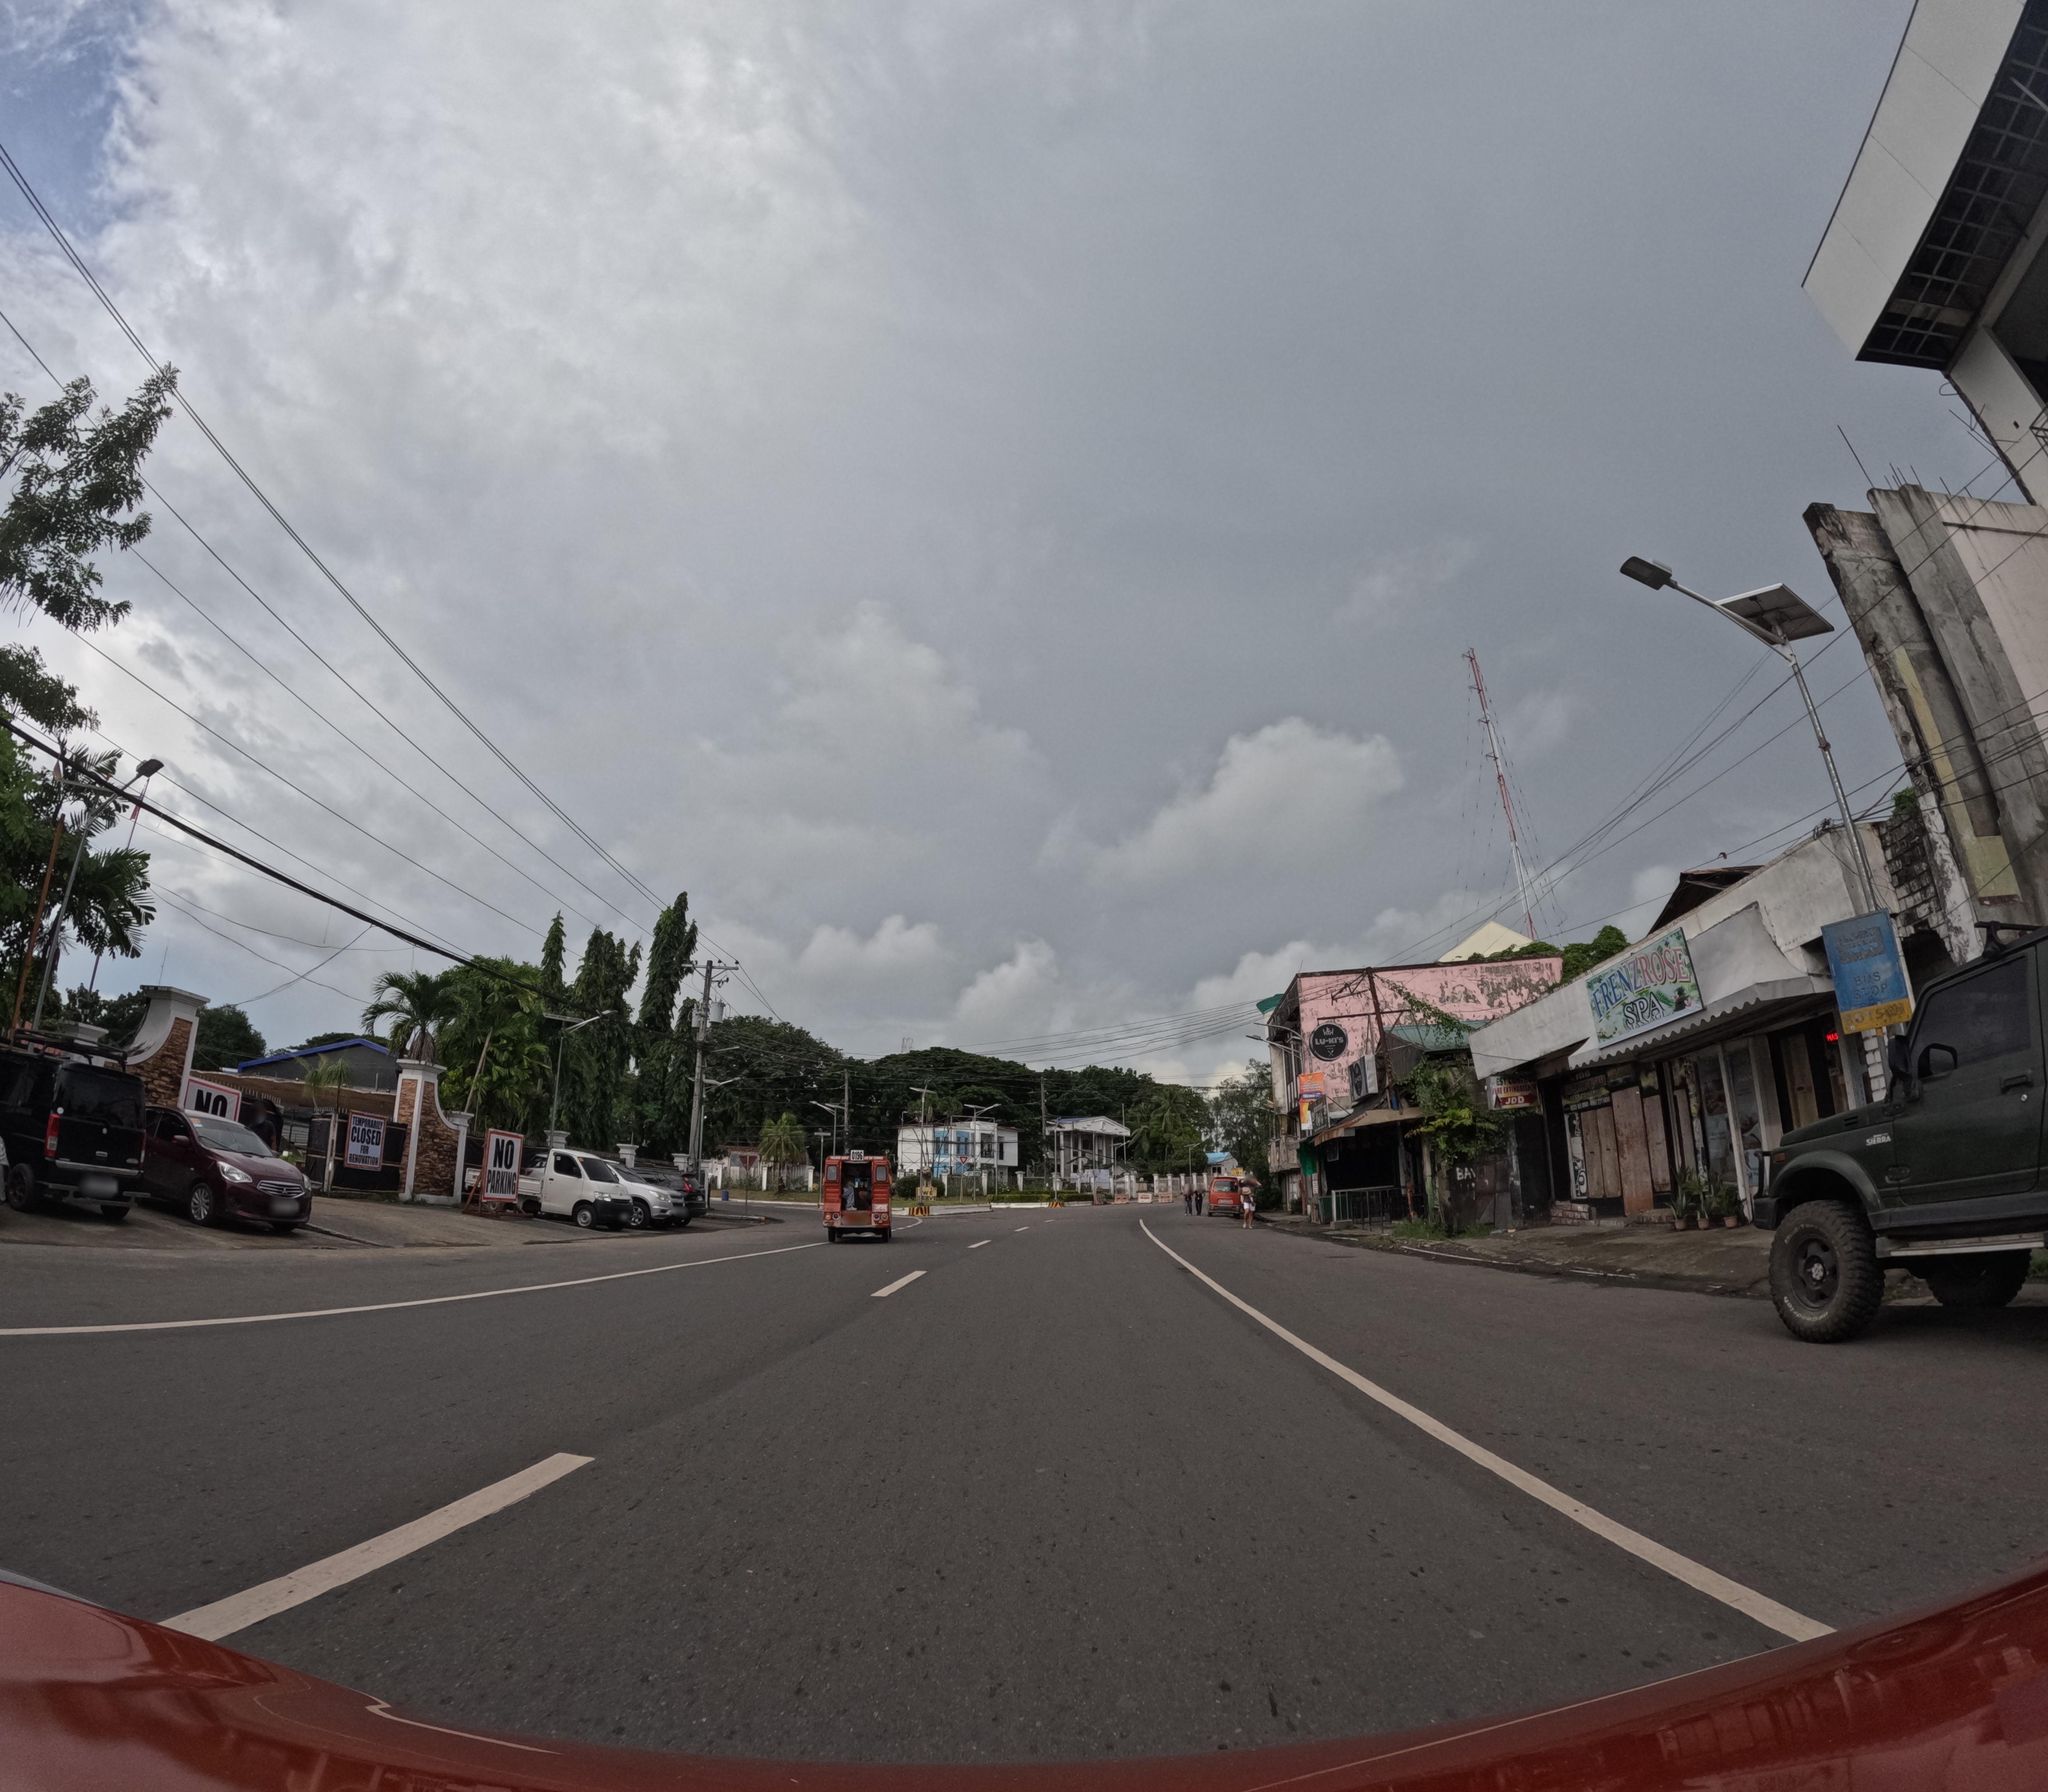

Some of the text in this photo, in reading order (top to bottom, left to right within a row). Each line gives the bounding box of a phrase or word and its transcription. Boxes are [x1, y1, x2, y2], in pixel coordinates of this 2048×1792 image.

[1593, 947, 1691, 1022] FRENZROSE
[1623, 992, 1664, 1028] SPA
[194, 1089, 228, 1118] NO
[351, 1126, 381, 1146] CLOSED
[360, 1145, 370, 1154] FOR
[493, 1138, 515, 1170] NO
[486, 1169, 517, 1195] PARKING
